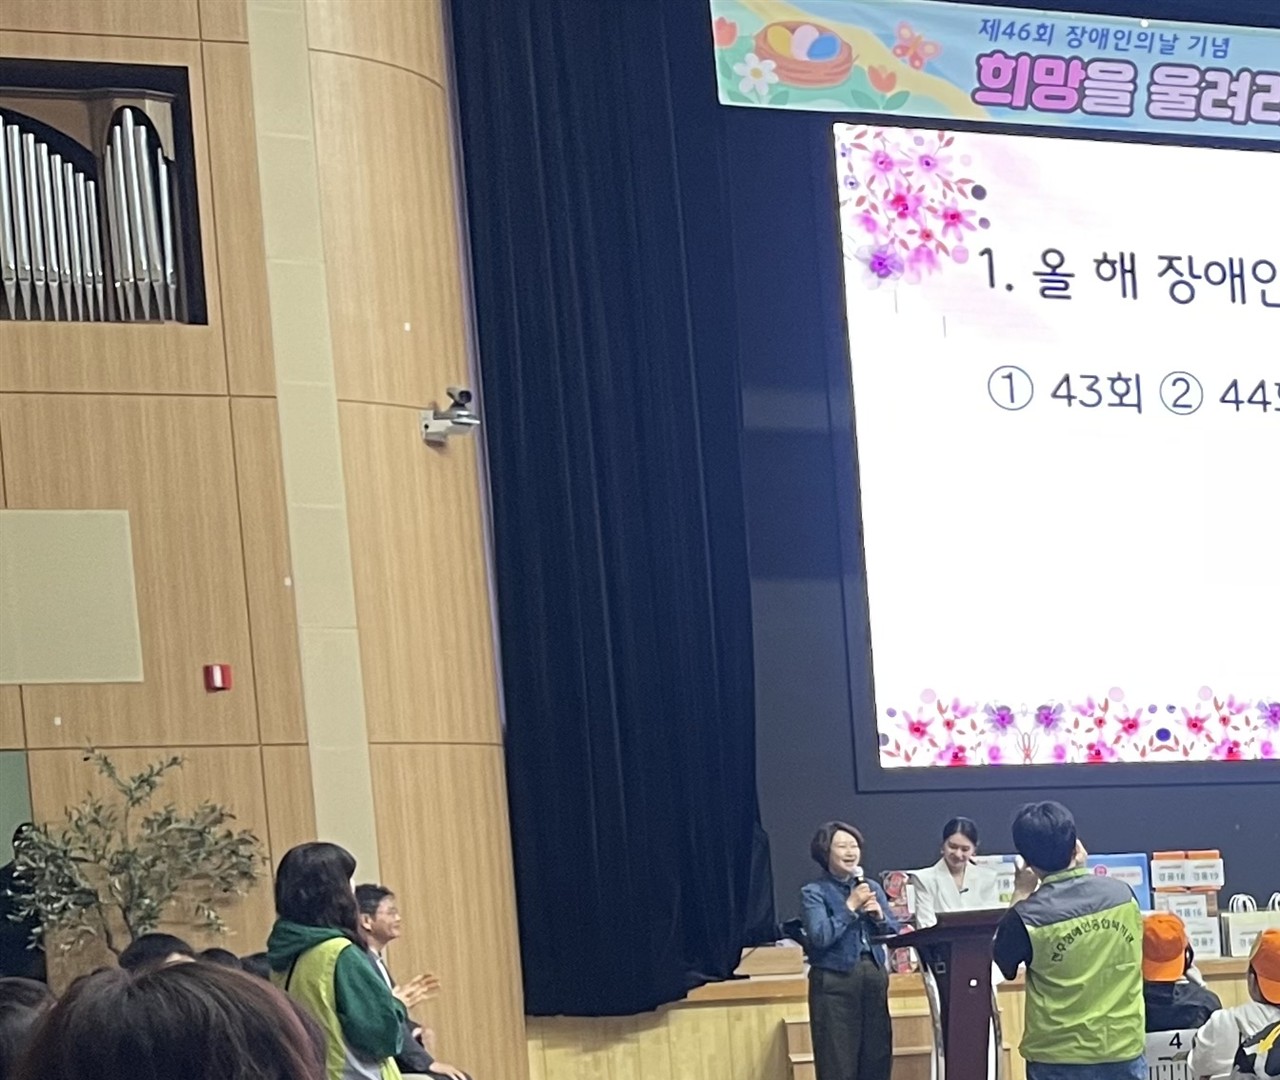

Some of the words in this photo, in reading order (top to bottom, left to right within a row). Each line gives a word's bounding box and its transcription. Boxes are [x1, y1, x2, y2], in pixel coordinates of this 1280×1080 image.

[979, 18, 1055, 46] 제46회
[1066, 25, 1179, 55] 장애인의날
[1188, 35, 1231, 59] 기념
[972, 50, 1138, 118] 희망을
[979, 248, 1013, 291] 1.
[1033, 249, 1075, 299] 올
[1094, 252, 1137, 299] 해
[1051, 372, 1141, 413] 43회
[1169, 1032, 1183, 1049] 4
